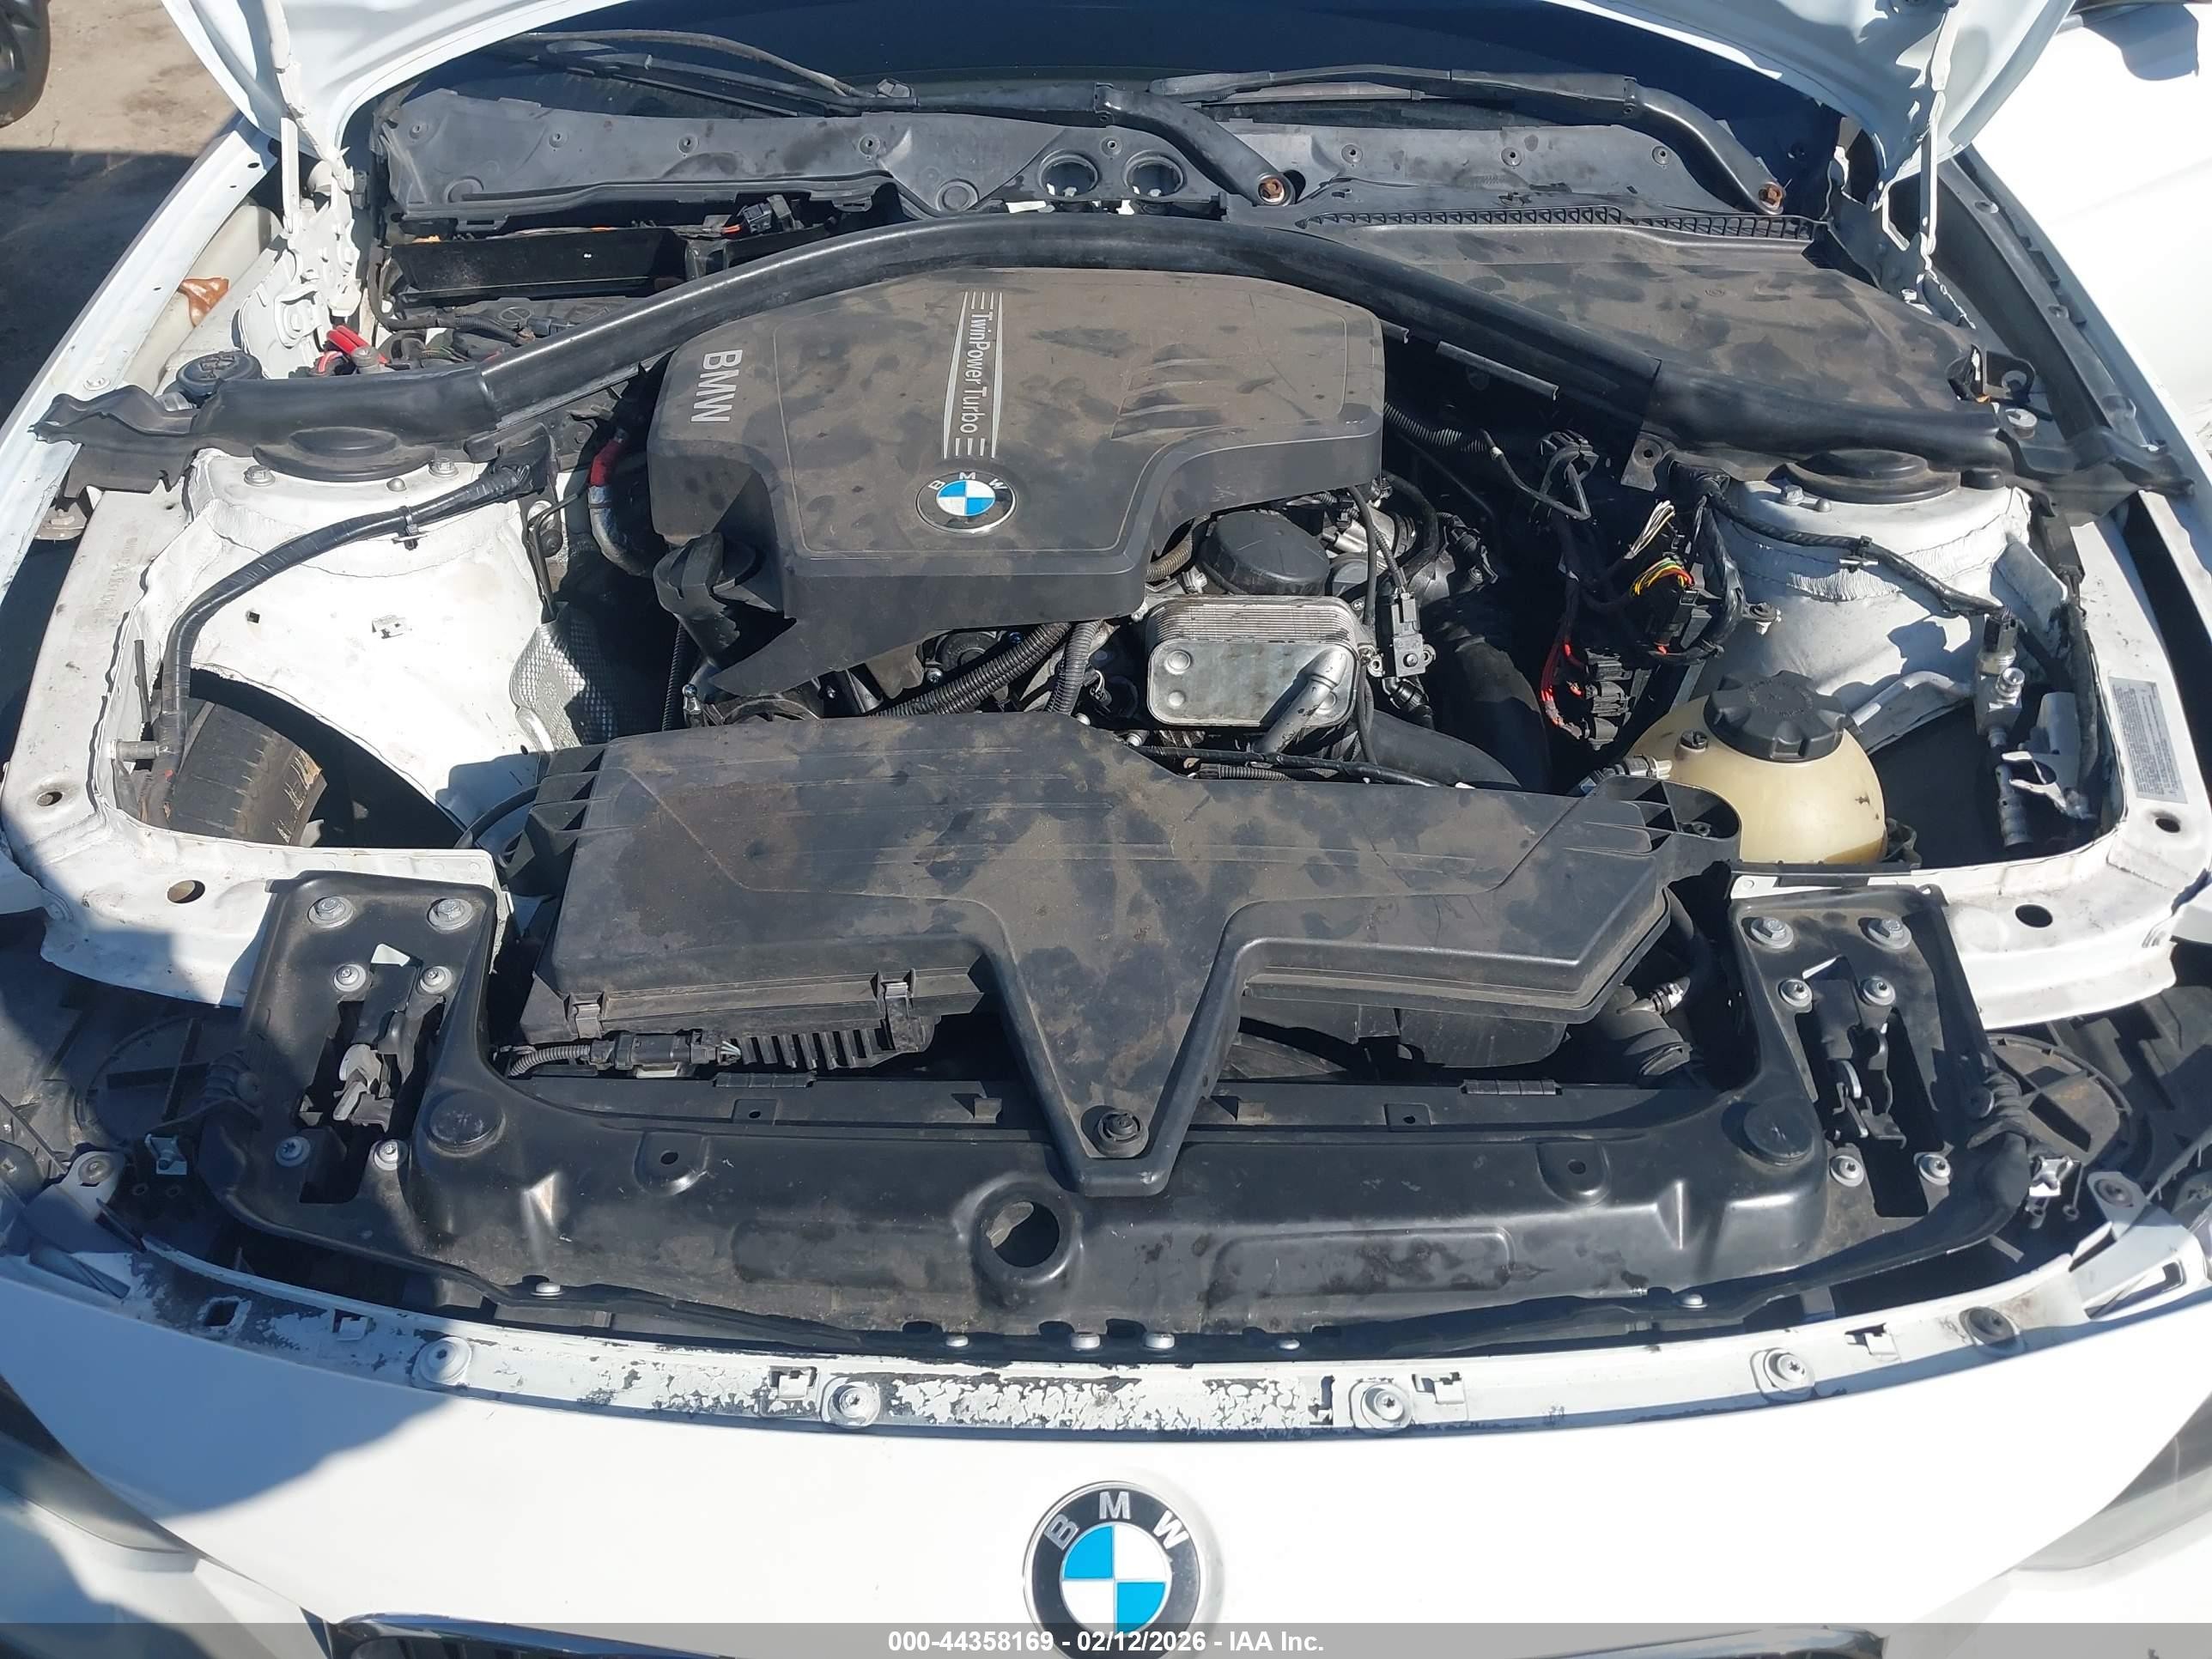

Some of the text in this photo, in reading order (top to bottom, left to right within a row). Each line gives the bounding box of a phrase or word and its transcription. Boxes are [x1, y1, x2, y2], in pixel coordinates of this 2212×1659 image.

[691, 349, 743, 422] BMW
[960, 312, 994, 433] TwinPower Turbo
[928, 471, 1008, 490] BMW
[1044, 1491, 1190, 1551] BMW
